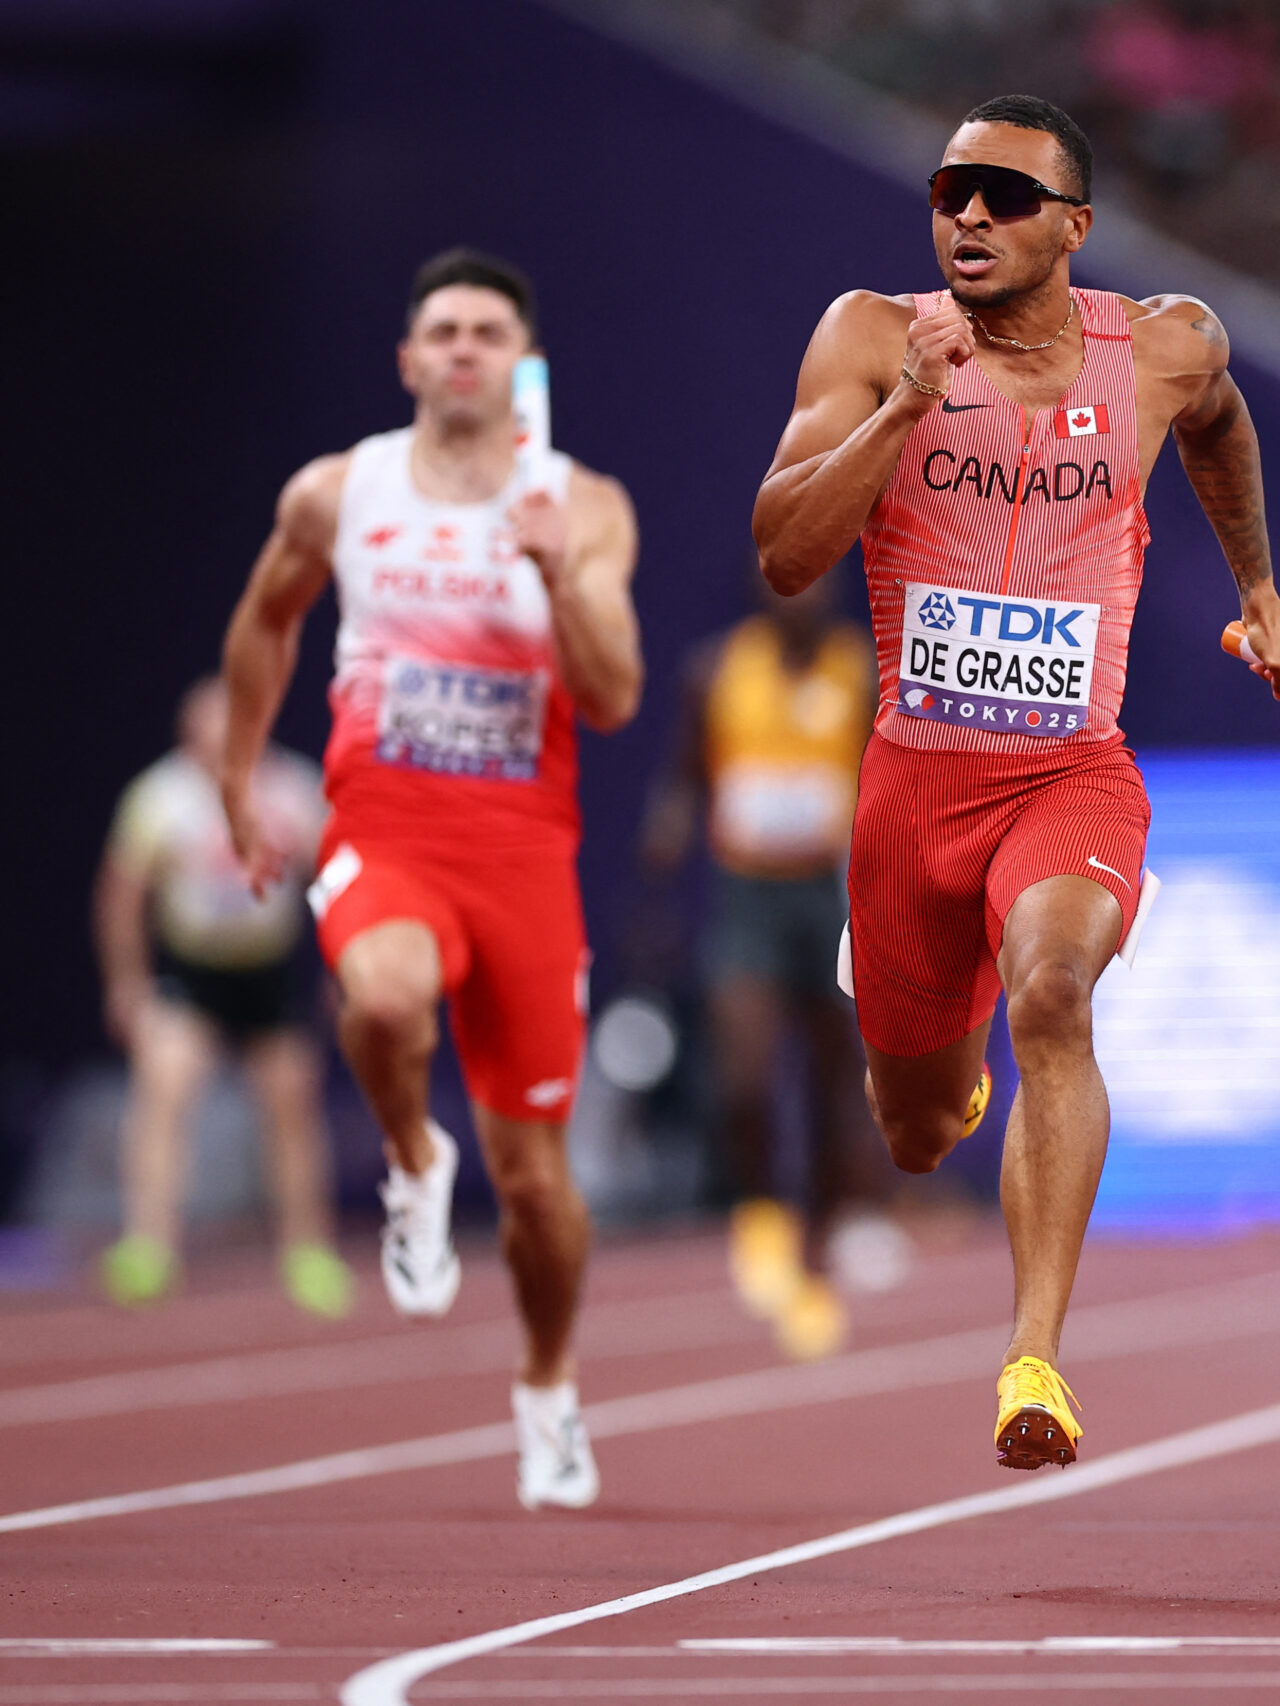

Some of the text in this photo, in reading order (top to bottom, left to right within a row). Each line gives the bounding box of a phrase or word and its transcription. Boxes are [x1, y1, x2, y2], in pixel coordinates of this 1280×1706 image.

[923, 450, 1112, 505] CANADA
[957, 596, 1085, 648] TDK
[910, 637, 1085, 699] DE GRASSE
